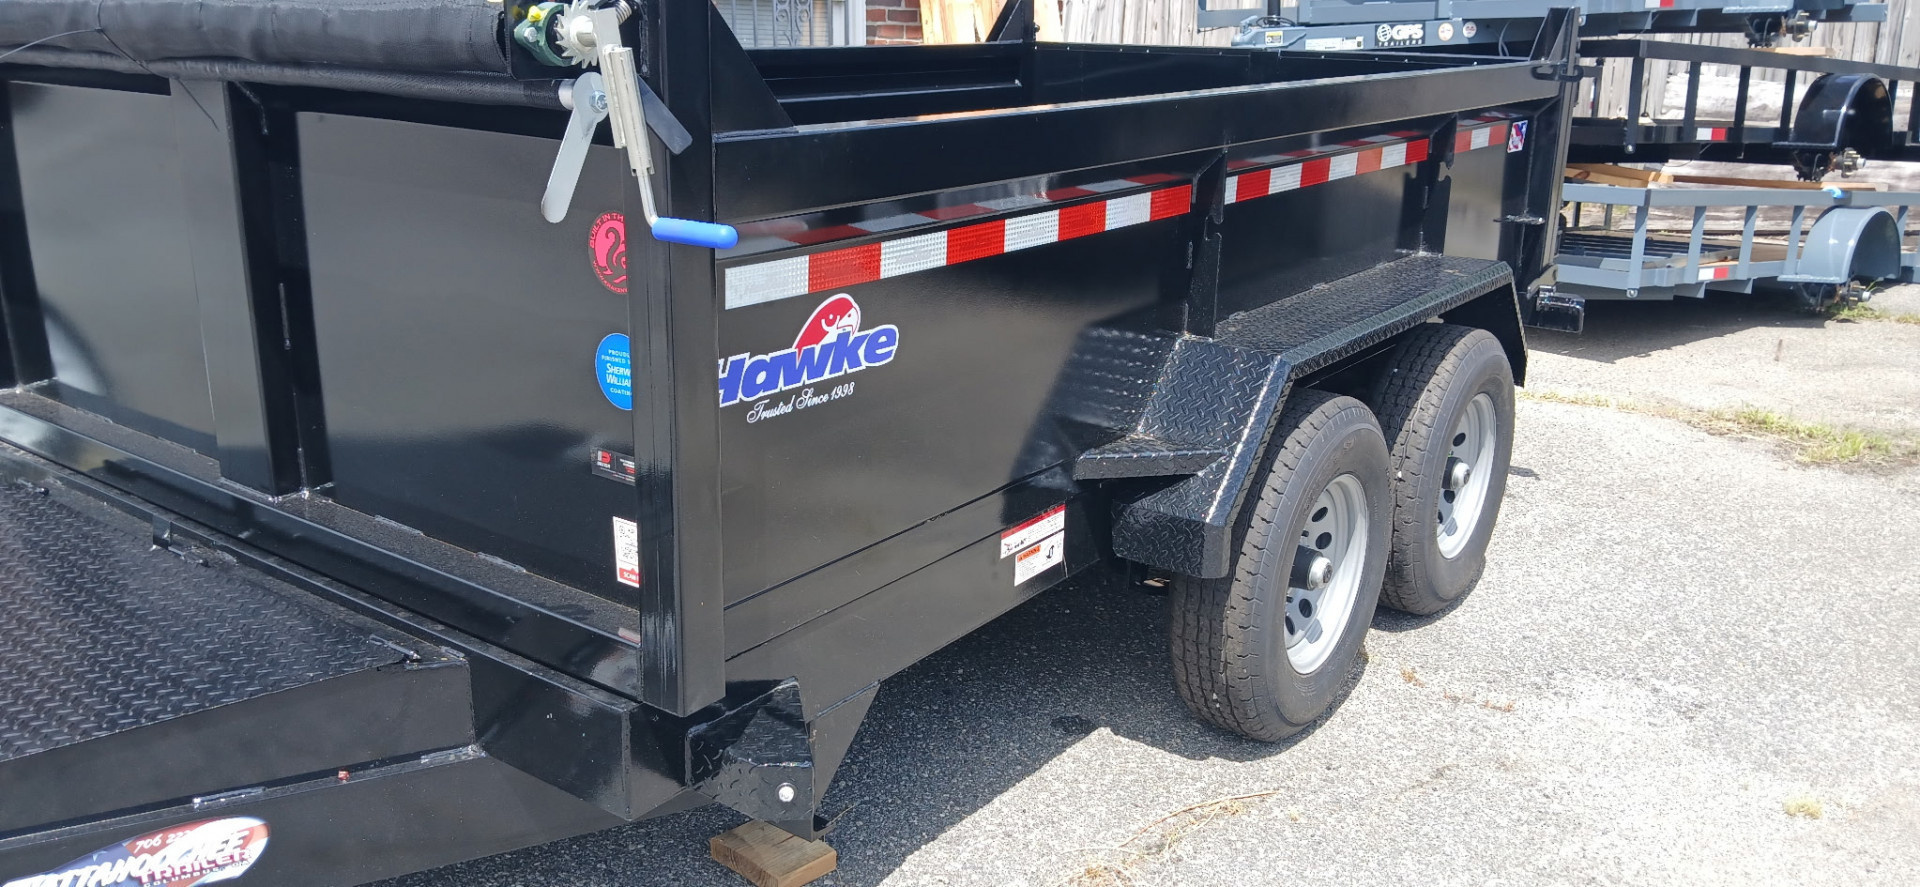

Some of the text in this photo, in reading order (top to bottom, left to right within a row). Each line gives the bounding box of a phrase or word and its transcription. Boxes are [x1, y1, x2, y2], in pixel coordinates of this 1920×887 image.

[590, 218, 602, 248] BUILT
[612, 212, 624, 222] TH
[608, 348, 630, 358] PROUD
[719, 324, 899, 407] Hawke
[746, 381, 855, 423] Trusted Since 1998
[133, 833, 163, 855] 706
